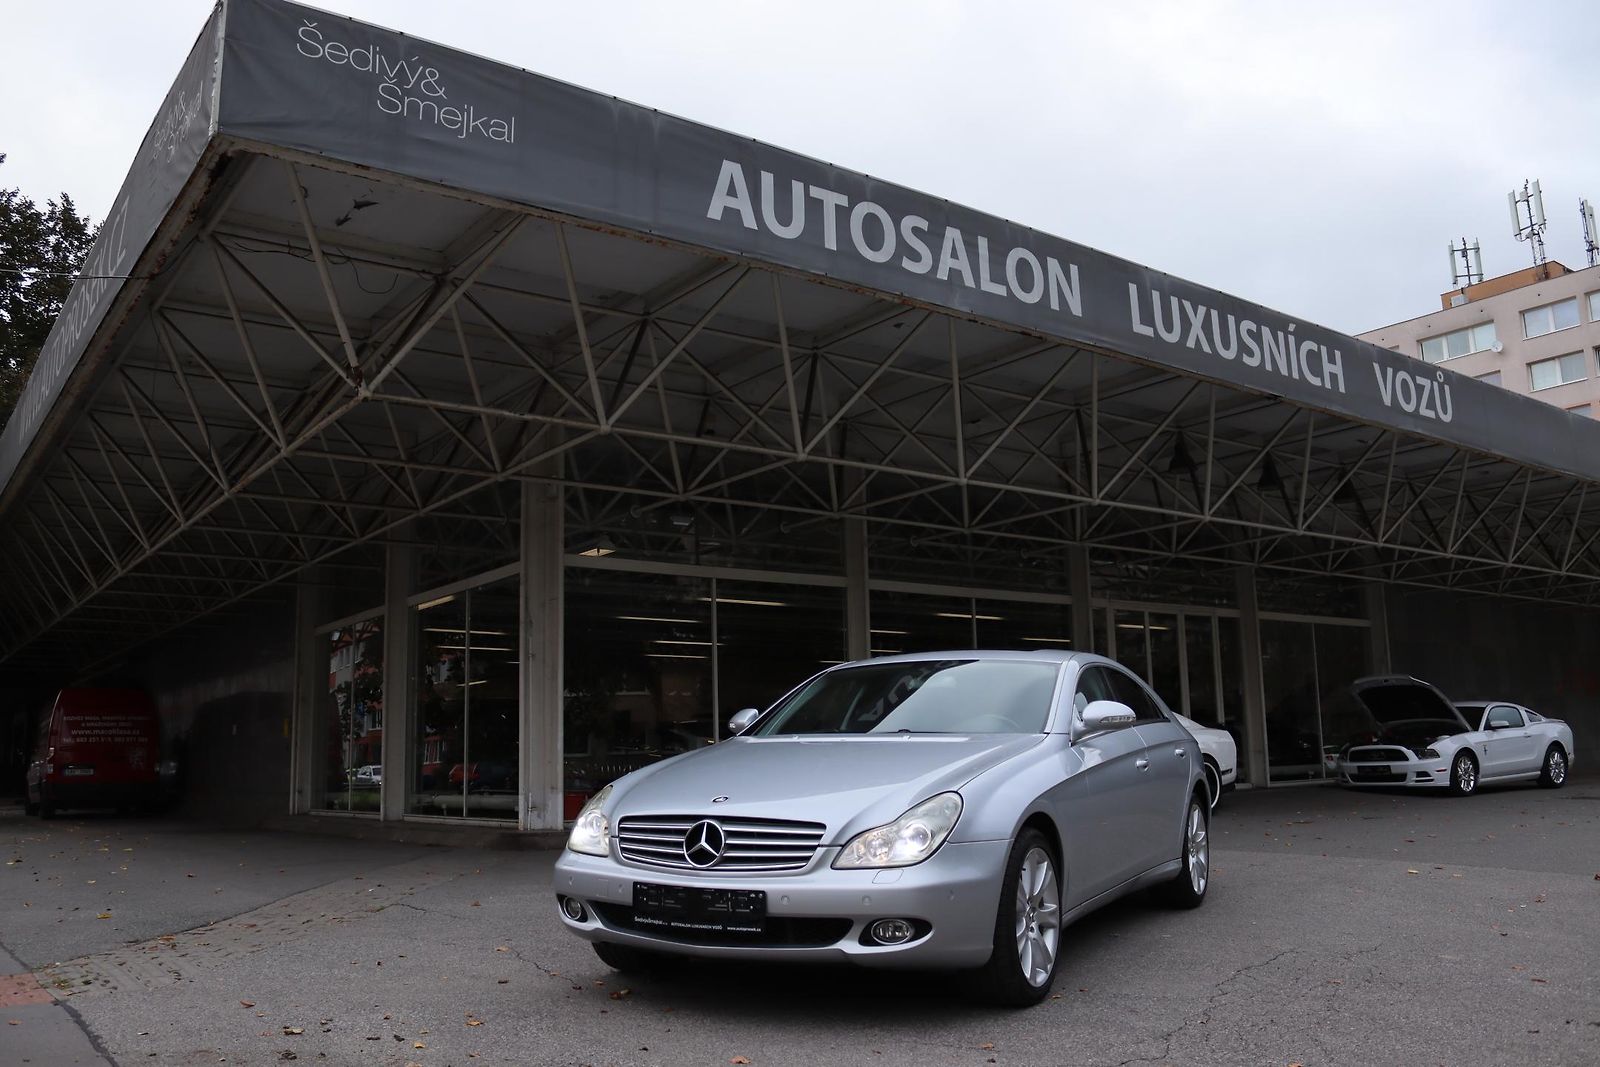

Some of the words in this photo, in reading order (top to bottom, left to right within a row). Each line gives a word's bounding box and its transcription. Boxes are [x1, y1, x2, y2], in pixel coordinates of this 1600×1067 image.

[296, 19, 448, 99] Šedivý&
[377, 75, 515, 144] Šmejkal
[706, 159, 1083, 318] AUTOSALON
[1128, 282, 1347, 394] LUXUSNÍCH
[1373, 370, 1454, 423] VOZŮ
